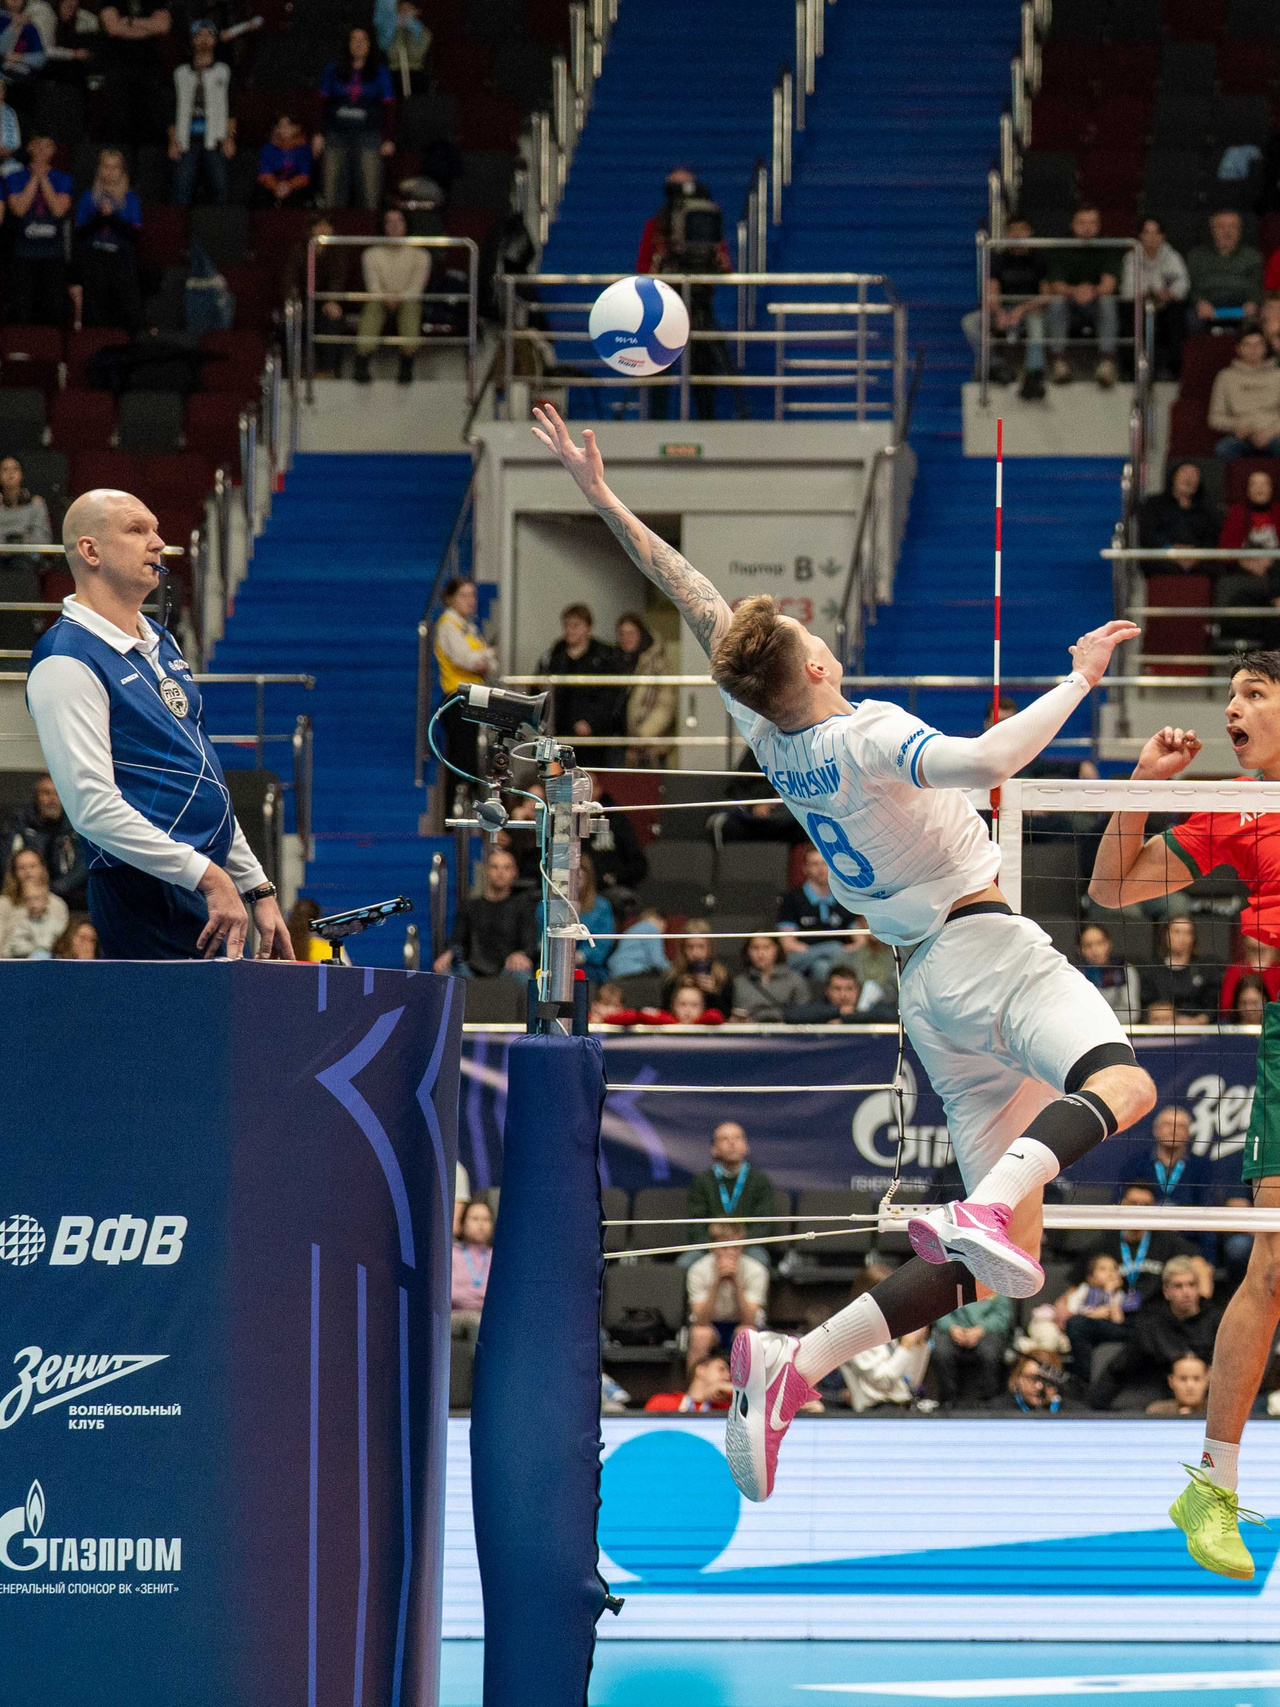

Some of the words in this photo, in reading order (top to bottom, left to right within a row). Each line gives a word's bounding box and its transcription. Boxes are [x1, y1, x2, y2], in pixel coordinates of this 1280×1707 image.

[806, 812, 875, 888] 8
[1253, 1136, 1260, 1161] 1
[49, 1214, 188, 1266] ВФВ
[0, 1345, 171, 1430] Зенит
[68, 1403, 182, 1416] ВОЛЕЙБОЛЬНЫЙ
[68, 1419, 105, 1430] КЛУБ
[49, 1537, 182, 1572] ГАЗПРОМ
[0, 1582, 65, 1594] ЕНЕРАЛЬНЫЙ
[67, 1583, 116, 1594] СПОНСОР
[119, 1583, 132, 1594] ВК
[135, 1583, 179, 1594] «ЗЕНИТ»
